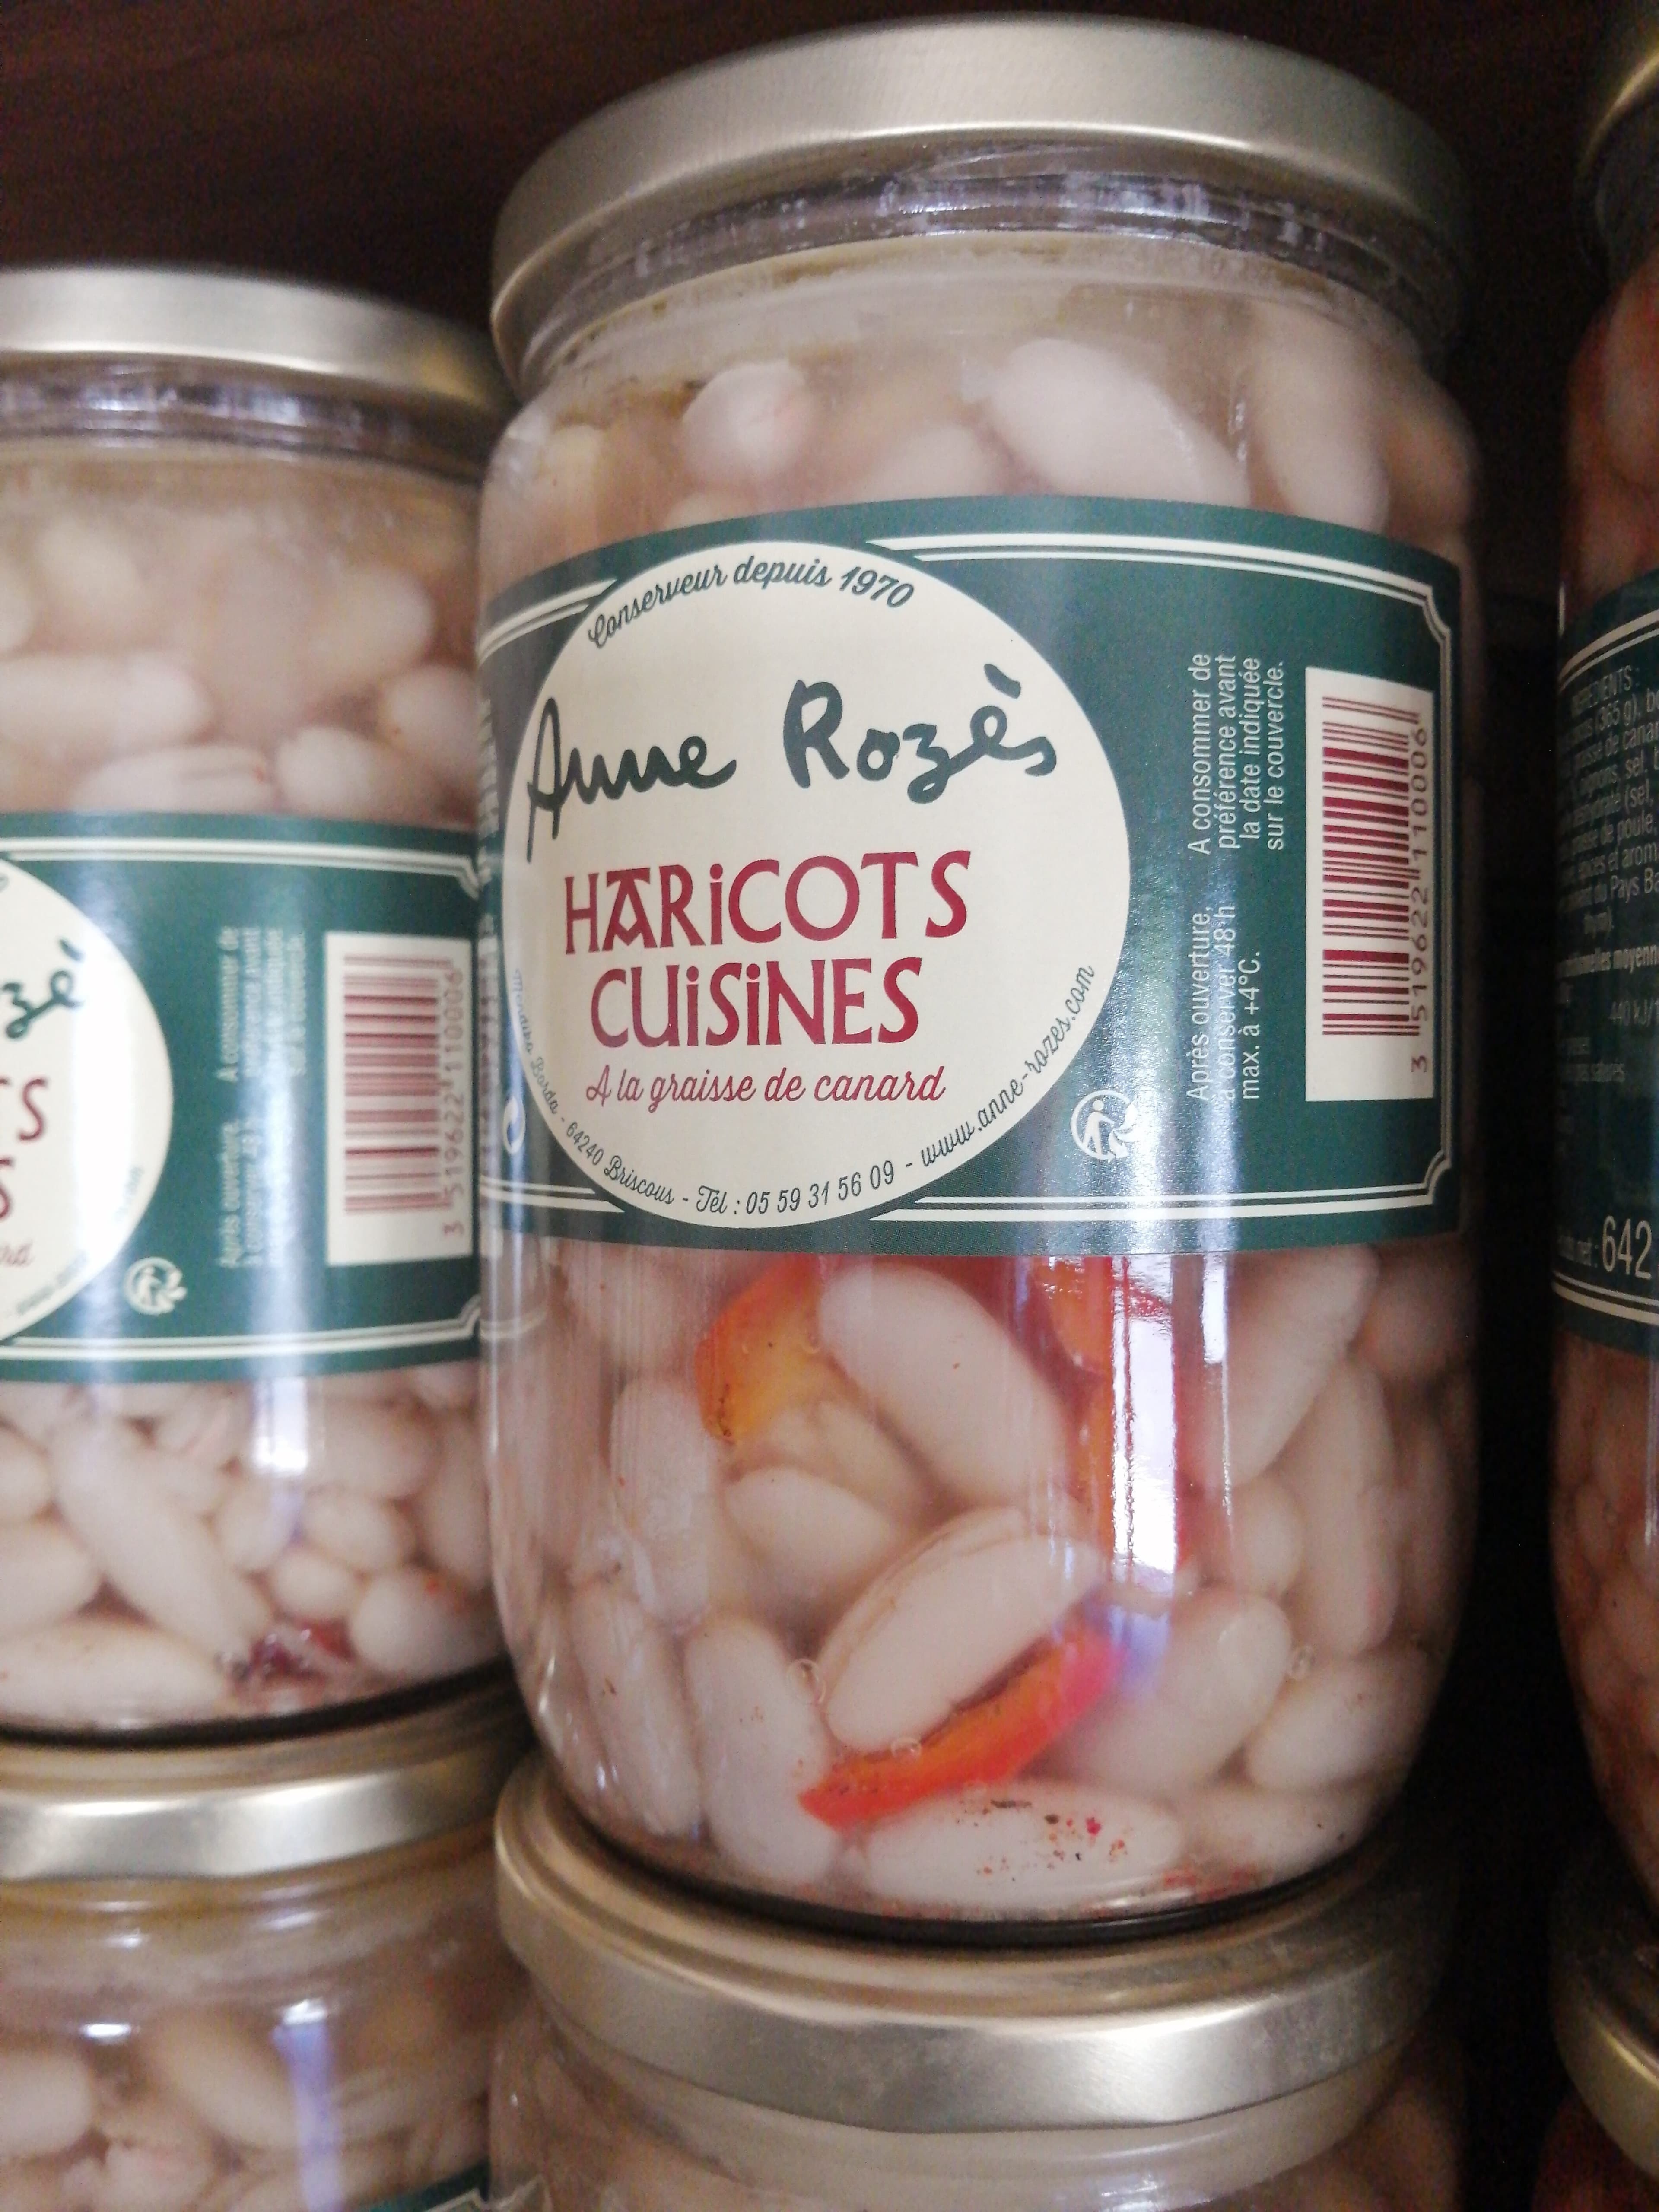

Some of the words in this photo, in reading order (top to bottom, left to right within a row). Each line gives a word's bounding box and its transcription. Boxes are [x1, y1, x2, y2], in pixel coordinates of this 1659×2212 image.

[588, 565, 728, 648] Conserveur
[734, 556, 831, 589] depuis
[839, 566, 914, 607] 1970
[1188, 654, 1211, 681] de
[1215, 655, 1236, 718] avant
[1239, 658, 1264, 755] indiquée
[1263, 662, 1284, 778] couvercle.
[1192, 691, 1211, 830] consommer
[1622, 721, 1659, 750] canar
[526, 698, 737, 863] Anne
[783, 664, 1056, 803] Rozès
[1213, 726, 1239, 849] préférence
[1239, 765, 1260, 813] date
[1264, 786, 1284, 805] le
[1187, 838, 1211, 855] A
[1239, 824, 1260, 839] la
[1268, 816, 1284, 850] sur
[1610, 875, 1640, 903] Pays
[1188, 906, 1211, 1025] ouverture,
[1214, 929, 1236, 957] 48
[1217, 964, 1236, 1079] conserver
[1239, 1025, 1259, 1036] à
[566, 1122, 605, 1166] 64240
[604, 1155, 674, 1204] Briscous
[746, 1191, 770, 1214] 05
[778, 1188, 800, 1213] 59
[808, 1181, 829, 1208] 31
[838, 1172, 861, 1200] 56
[870, 1160, 893, 1189] 09
[921, 966, 1094, 1167] www.anne-rozes.com
[586, 1065, 611, 1107] A
[618, 1068, 644, 1101] la
[650, 1069, 756, 1113] graisse
[765, 1068, 805, 1101] de
[814, 1066, 946, 1101] canard
[1186, 1034, 1213, 1100] Après
[1243, 1046, 1259, 1099] max.
[1411, 1055, 1427, 1073] 3
[1602, 1215, 1652, 1280] 642
